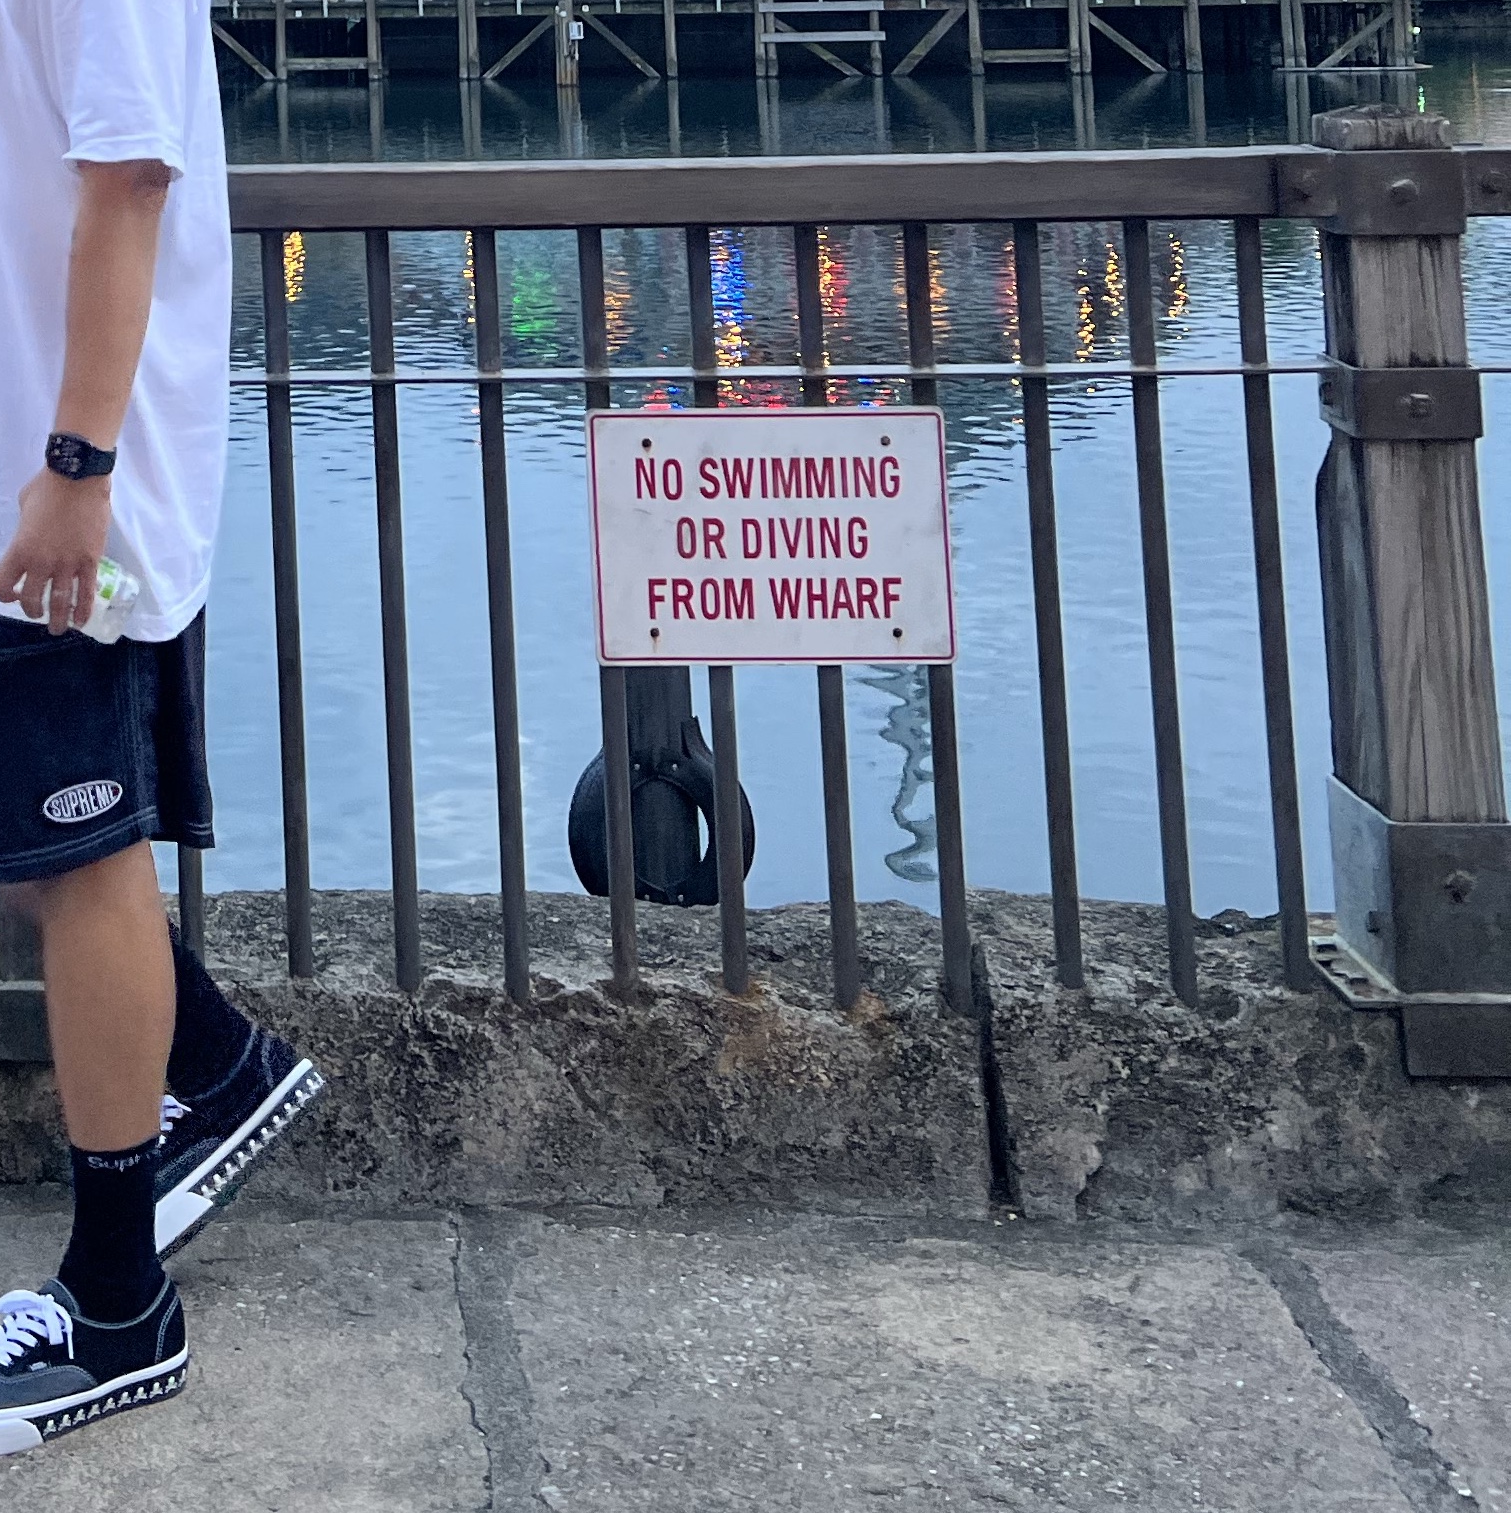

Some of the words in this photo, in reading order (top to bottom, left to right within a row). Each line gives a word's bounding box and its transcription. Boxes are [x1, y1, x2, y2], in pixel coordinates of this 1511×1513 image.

[635, 457, 683, 500] NO
[699, 455, 900, 499] SWIMMING
[676, 516, 727, 559] OR
[741, 516, 868, 559] DIVING
[648, 577, 755, 620] FROM
[768, 577, 902, 619] WHARF
